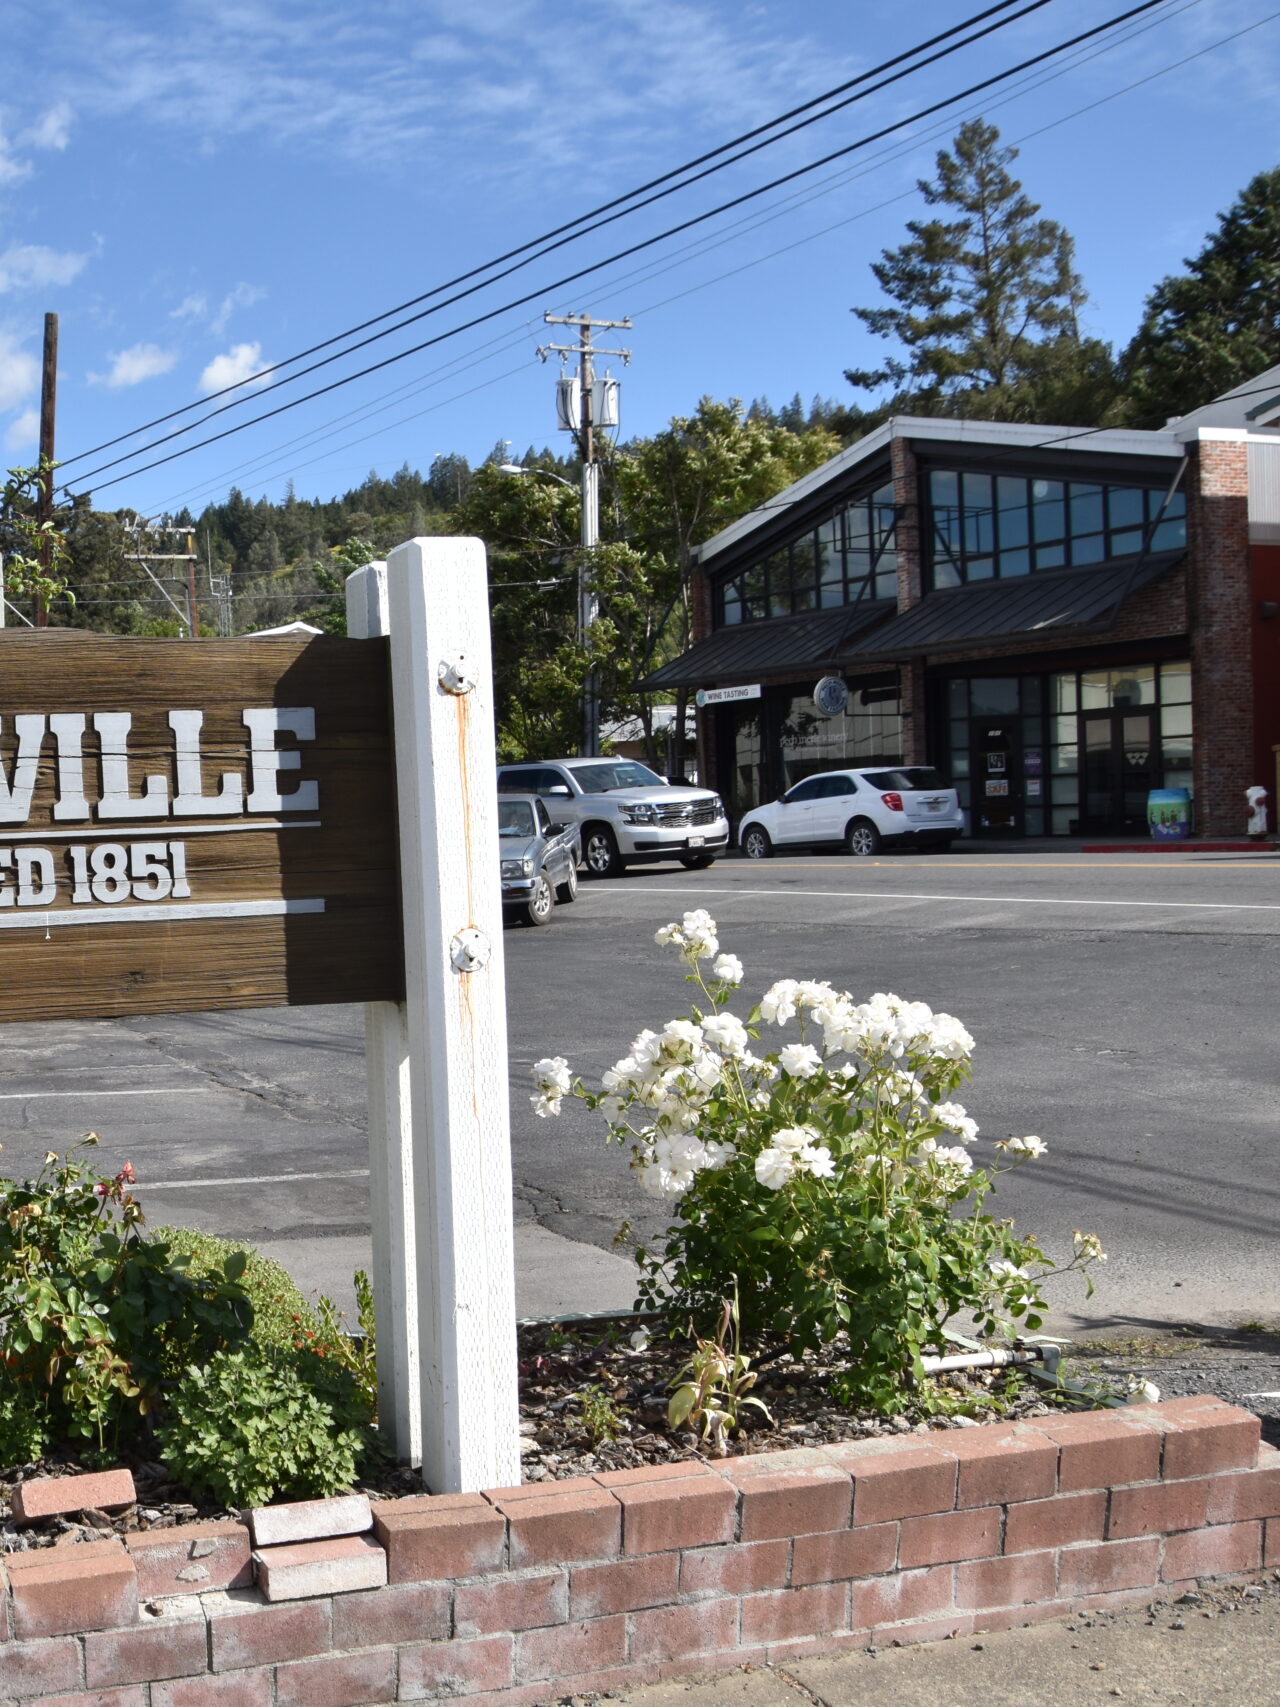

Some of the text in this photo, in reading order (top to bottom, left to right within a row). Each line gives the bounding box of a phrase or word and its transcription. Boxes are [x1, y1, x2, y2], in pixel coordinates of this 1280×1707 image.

[707, 692, 722, 701] WINE
[723, 689, 749, 699] TASTING
[71, 841, 191, 905] 1851
